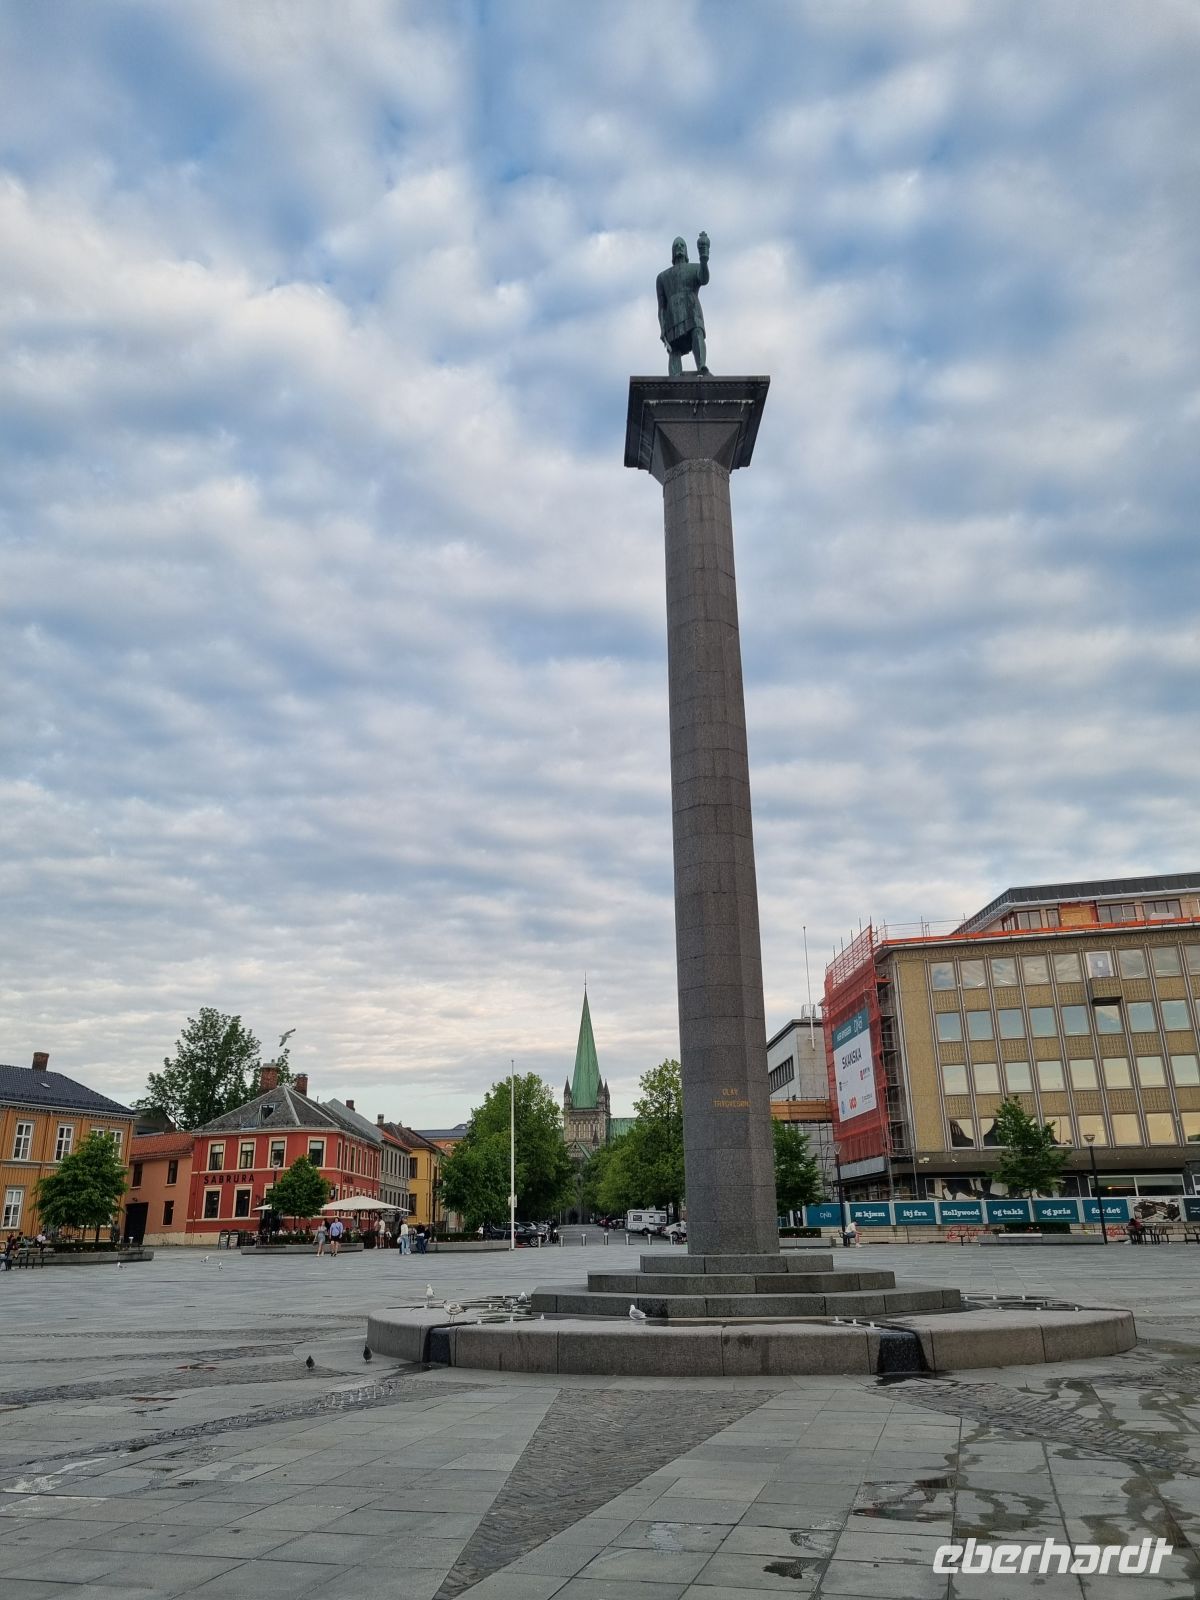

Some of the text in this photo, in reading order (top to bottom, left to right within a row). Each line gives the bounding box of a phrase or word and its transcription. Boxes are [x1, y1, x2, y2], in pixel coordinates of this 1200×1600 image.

[842, 1048, 862, 1069] SKANSKA
[203, 1173, 255, 1184] SABRURA
[942, 1208, 980, 1218] Hollywood
[1052, 1208, 1071, 1216] pris
